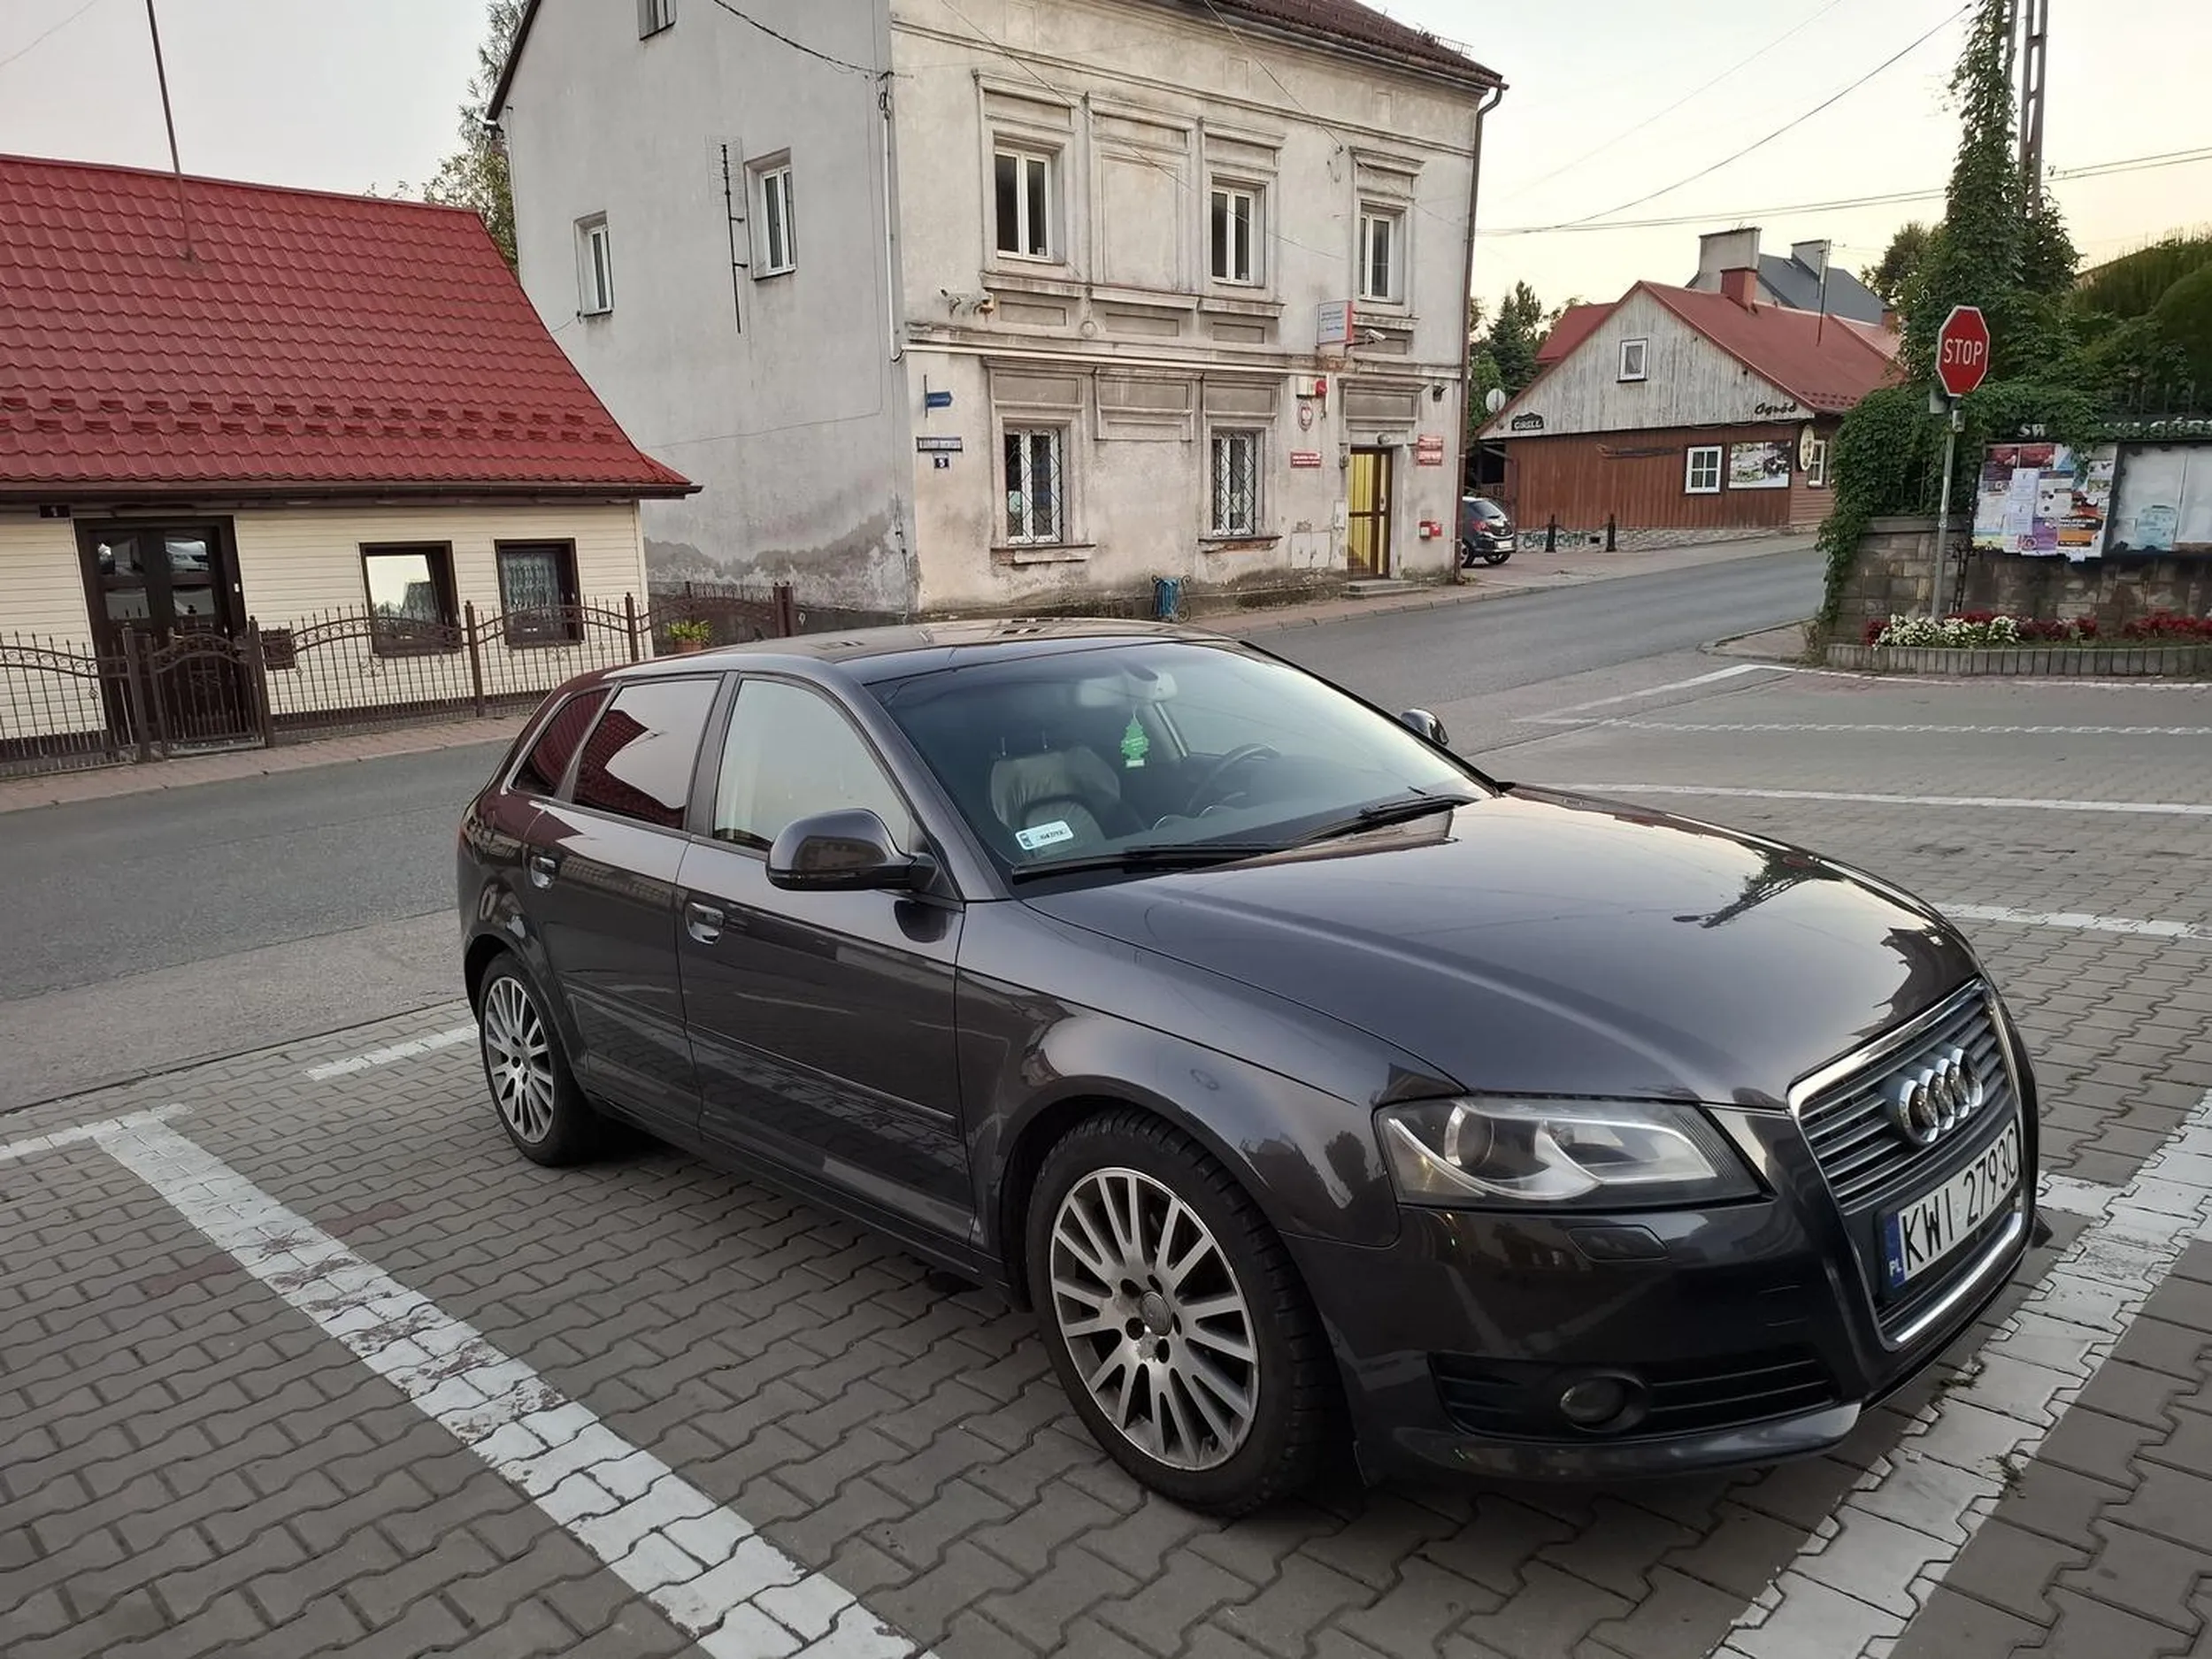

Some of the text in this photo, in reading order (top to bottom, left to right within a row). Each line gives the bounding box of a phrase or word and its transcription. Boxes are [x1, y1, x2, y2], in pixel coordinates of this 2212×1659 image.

[1944, 338, 1983, 366] STOP
[1755, 402, 1797, 416] Ogród
[1902, 1127, 2017, 1271] KWI 2793C
[1889, 1258, 1901, 1277] PL
